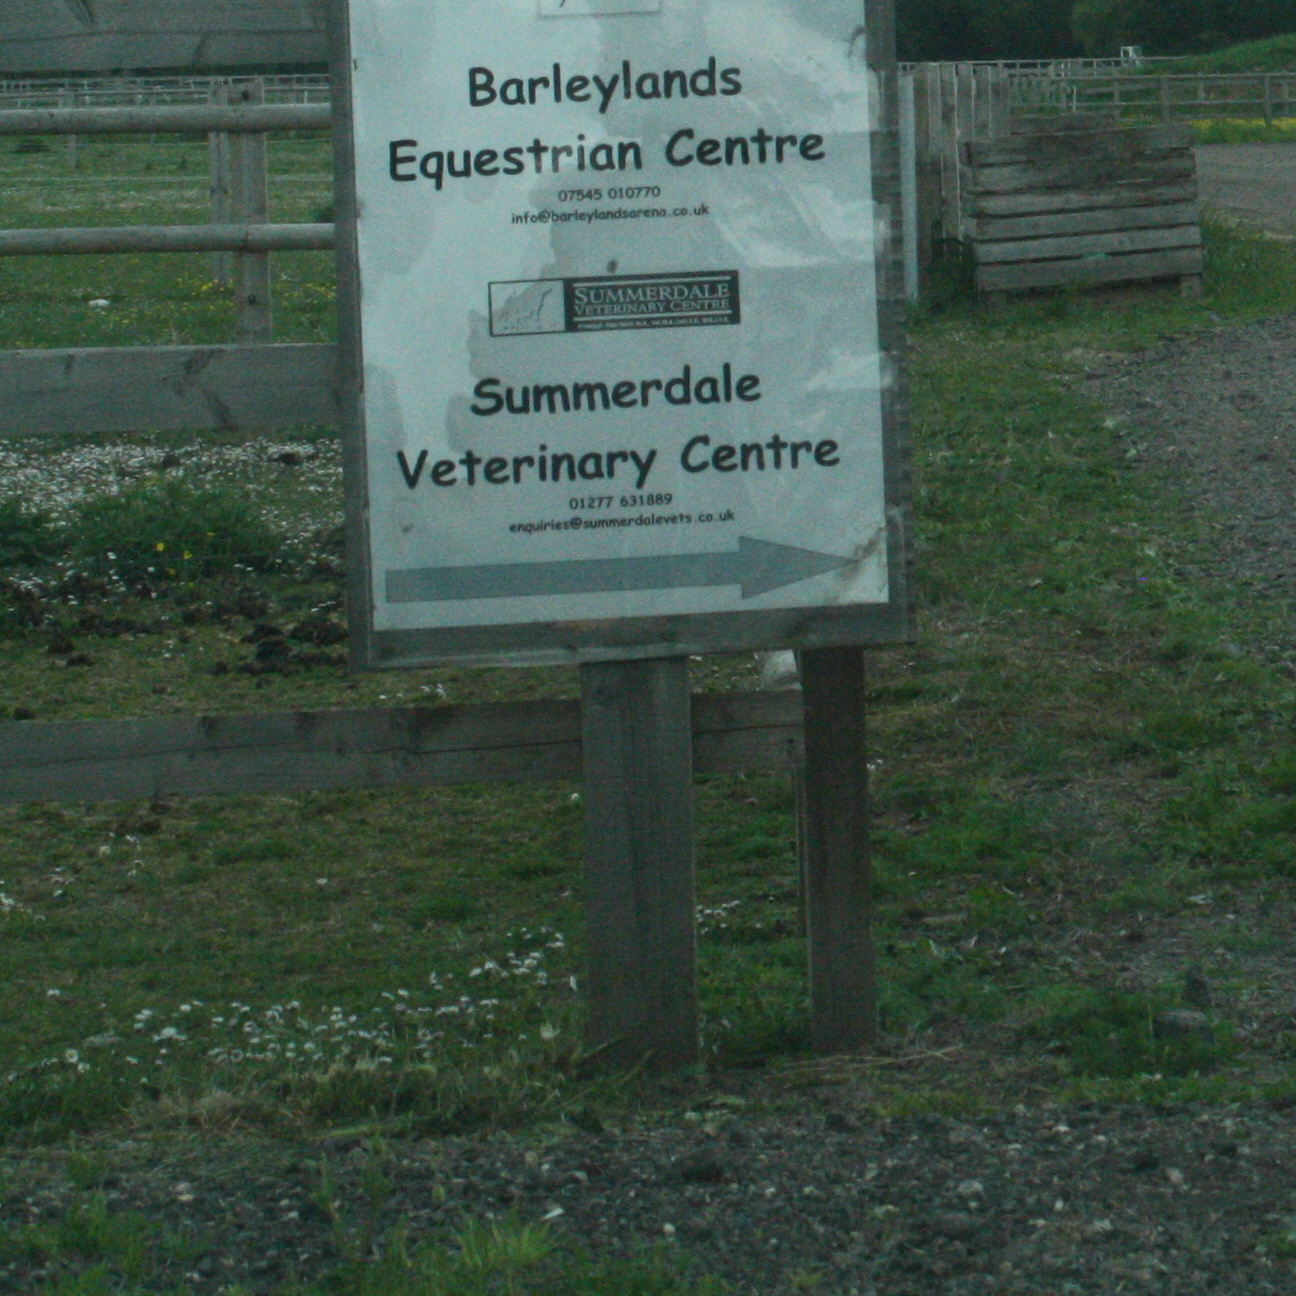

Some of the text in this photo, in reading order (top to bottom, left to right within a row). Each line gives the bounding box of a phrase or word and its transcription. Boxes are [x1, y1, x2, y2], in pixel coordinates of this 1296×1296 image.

[468, 56, 742, 114] Barleylands
[389, 128, 826, 190] Equestrian Centre
[558, 186, 661, 202] 07545 010770
[511, 203, 710, 224] info@barleylandsarena.co.uk
[574, 283, 730, 304] SUMMERDALE
[574, 299, 730, 316] VETERINARY CENTRE
[470, 363, 761, 417] Summerdale
[396, 433, 840, 490] Veterinary Centre
[569, 493, 673, 510] 01277 631889
